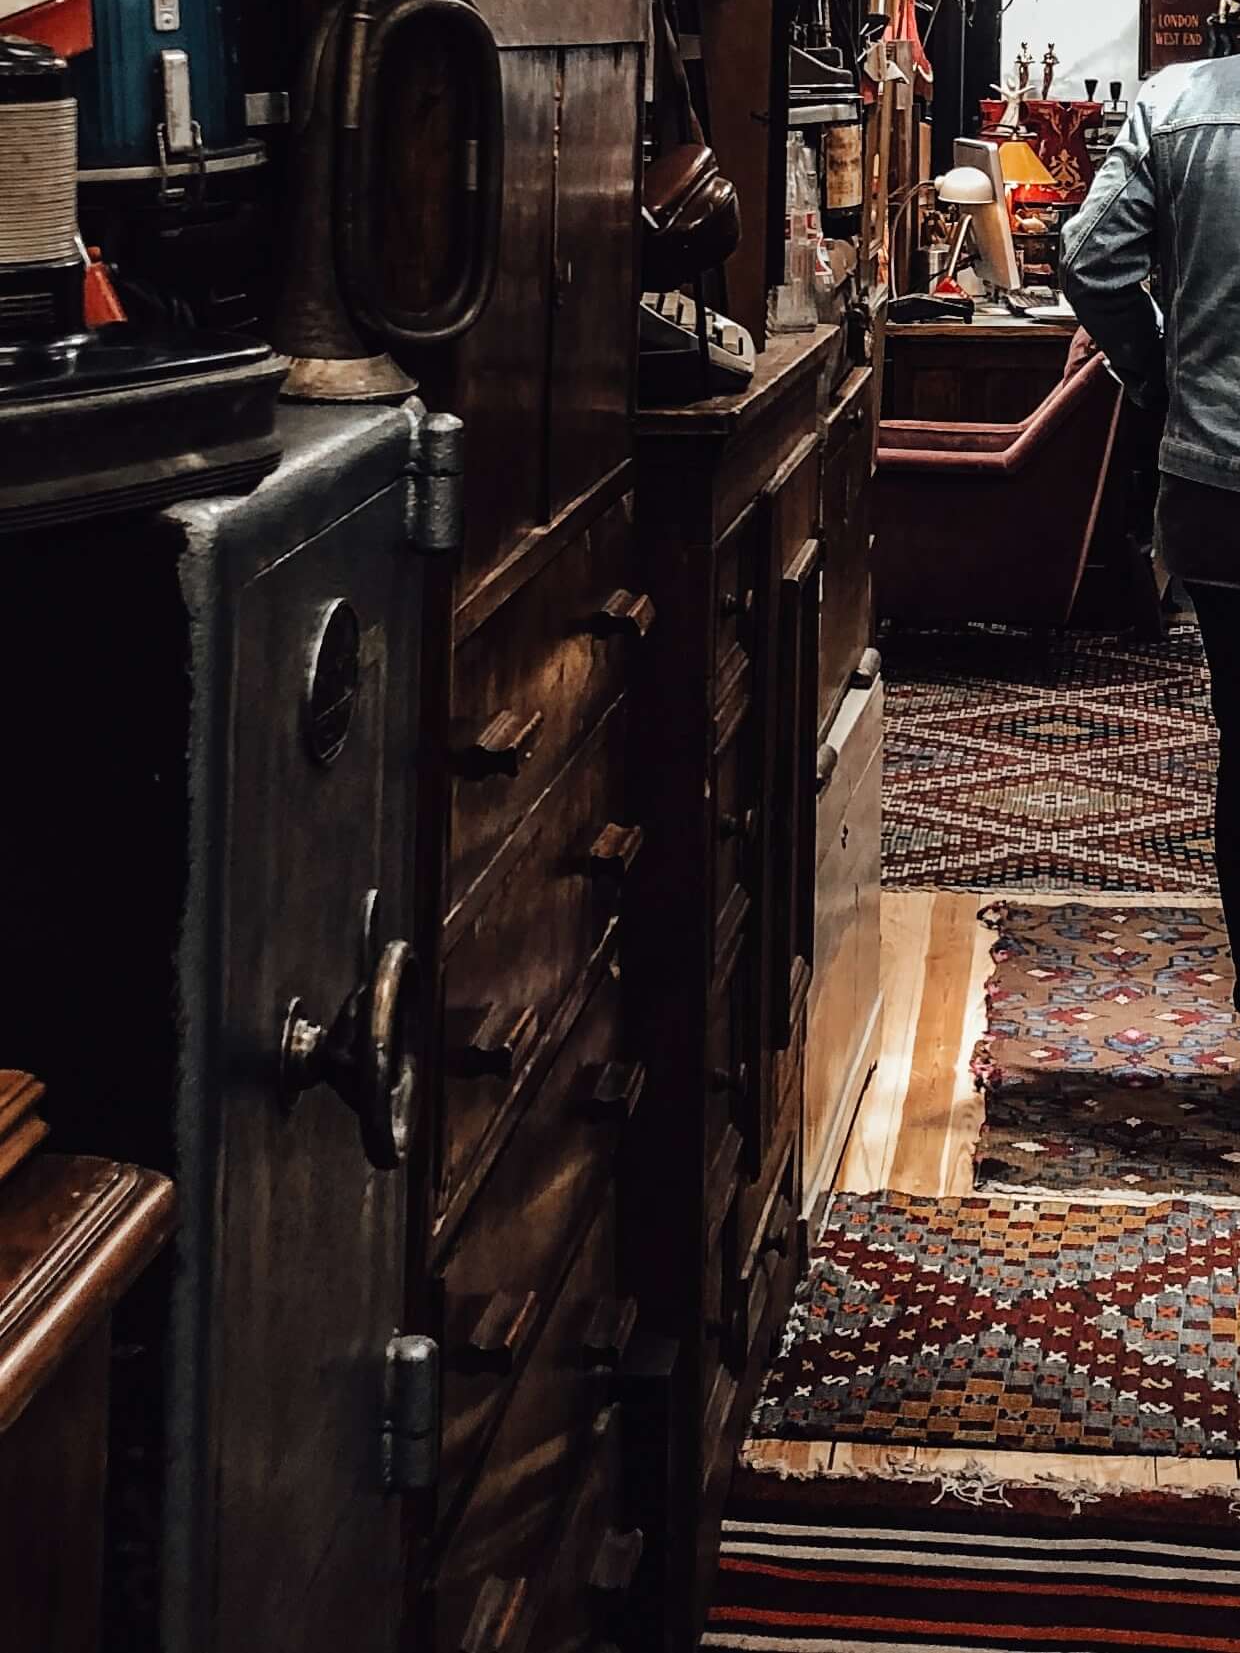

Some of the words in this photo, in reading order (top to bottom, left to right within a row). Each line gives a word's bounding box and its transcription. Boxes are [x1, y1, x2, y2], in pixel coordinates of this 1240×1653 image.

[1159, 14, 1199, 28] LONDON
[1155, 32, 1180, 45] WEST
[1183, 32, 1202, 45] END
